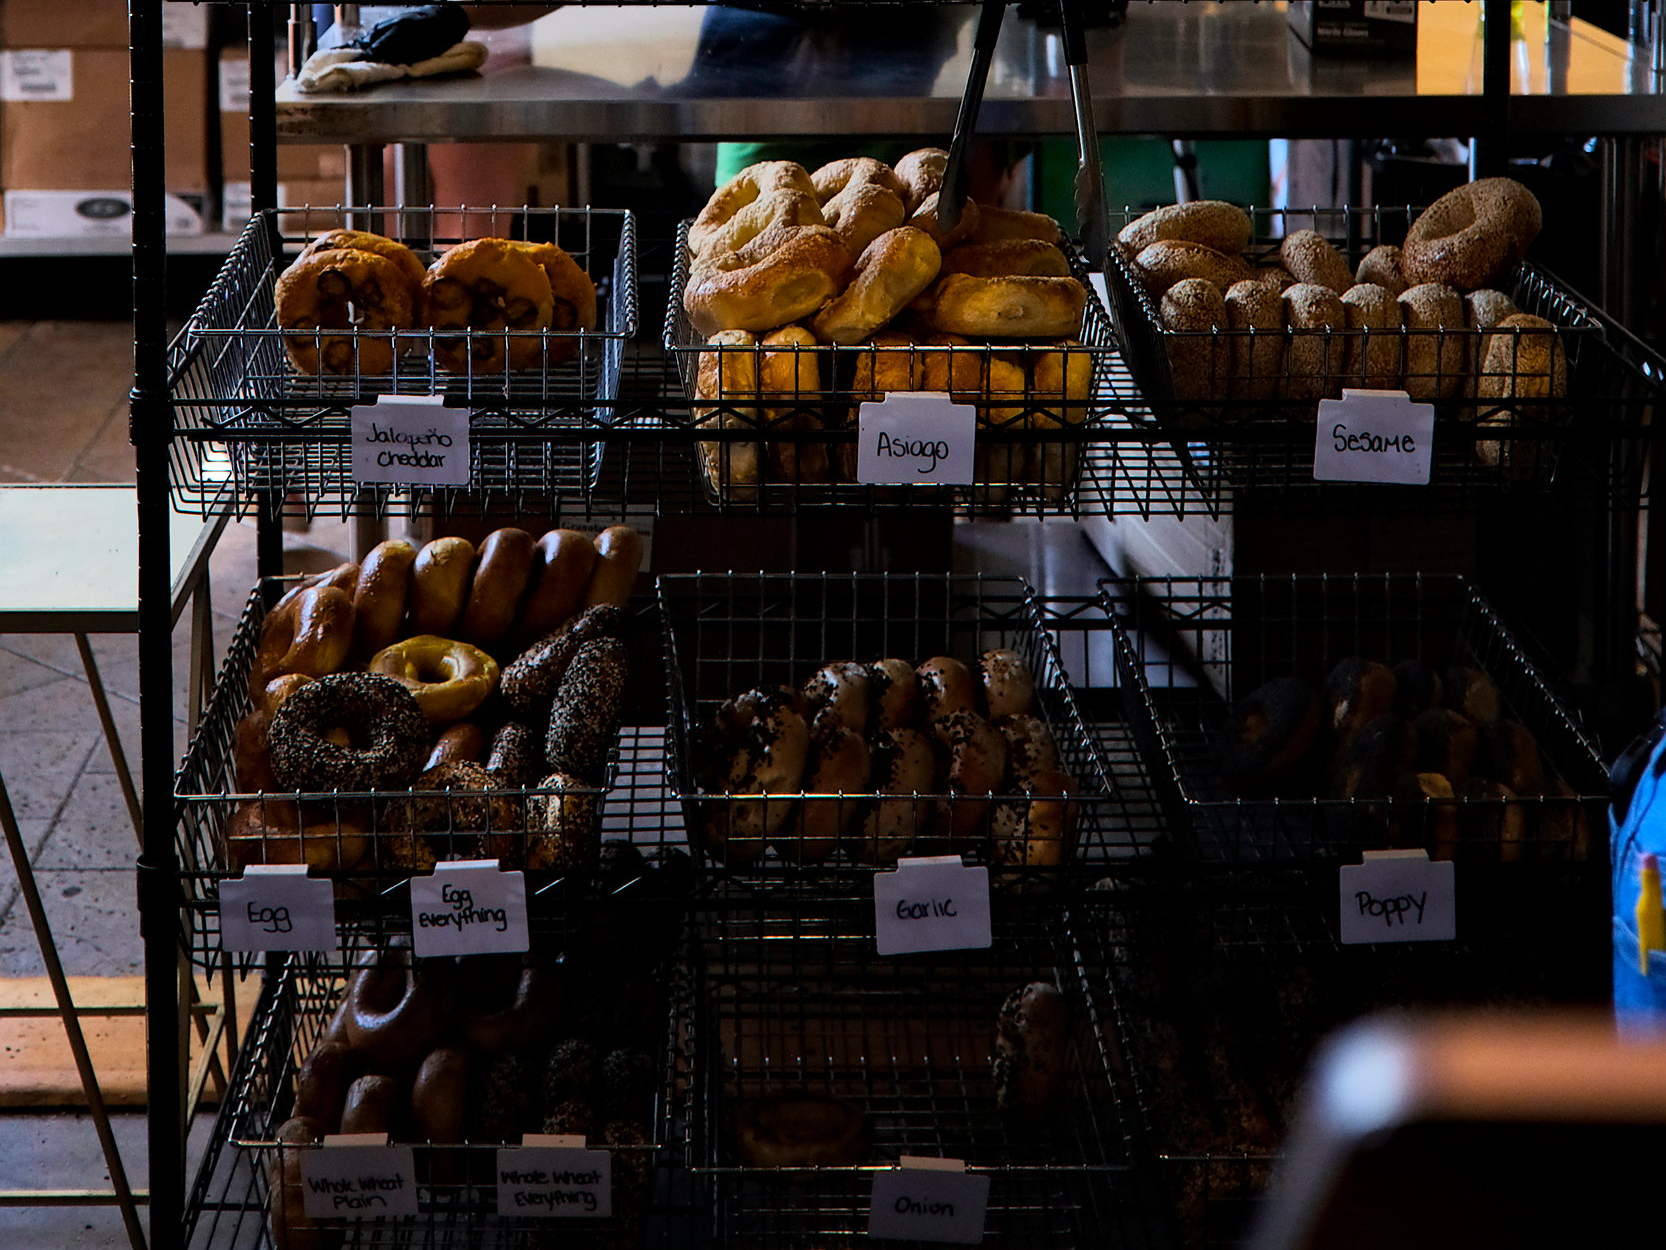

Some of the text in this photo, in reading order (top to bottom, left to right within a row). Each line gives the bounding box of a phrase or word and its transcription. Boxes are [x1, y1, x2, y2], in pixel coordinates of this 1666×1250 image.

[1332, 423, 1416, 453] Sesame
[876, 431, 950, 474] Asiago
[442, 883, 473, 910] Egg
[895, 898, 958, 921] Garlic
[1354, 890, 1428, 928] Poppy
[247, 901, 292, 934] Egg
[332, 1193, 388, 1211] Plain
[894, 1195, 955, 1218] Onion
